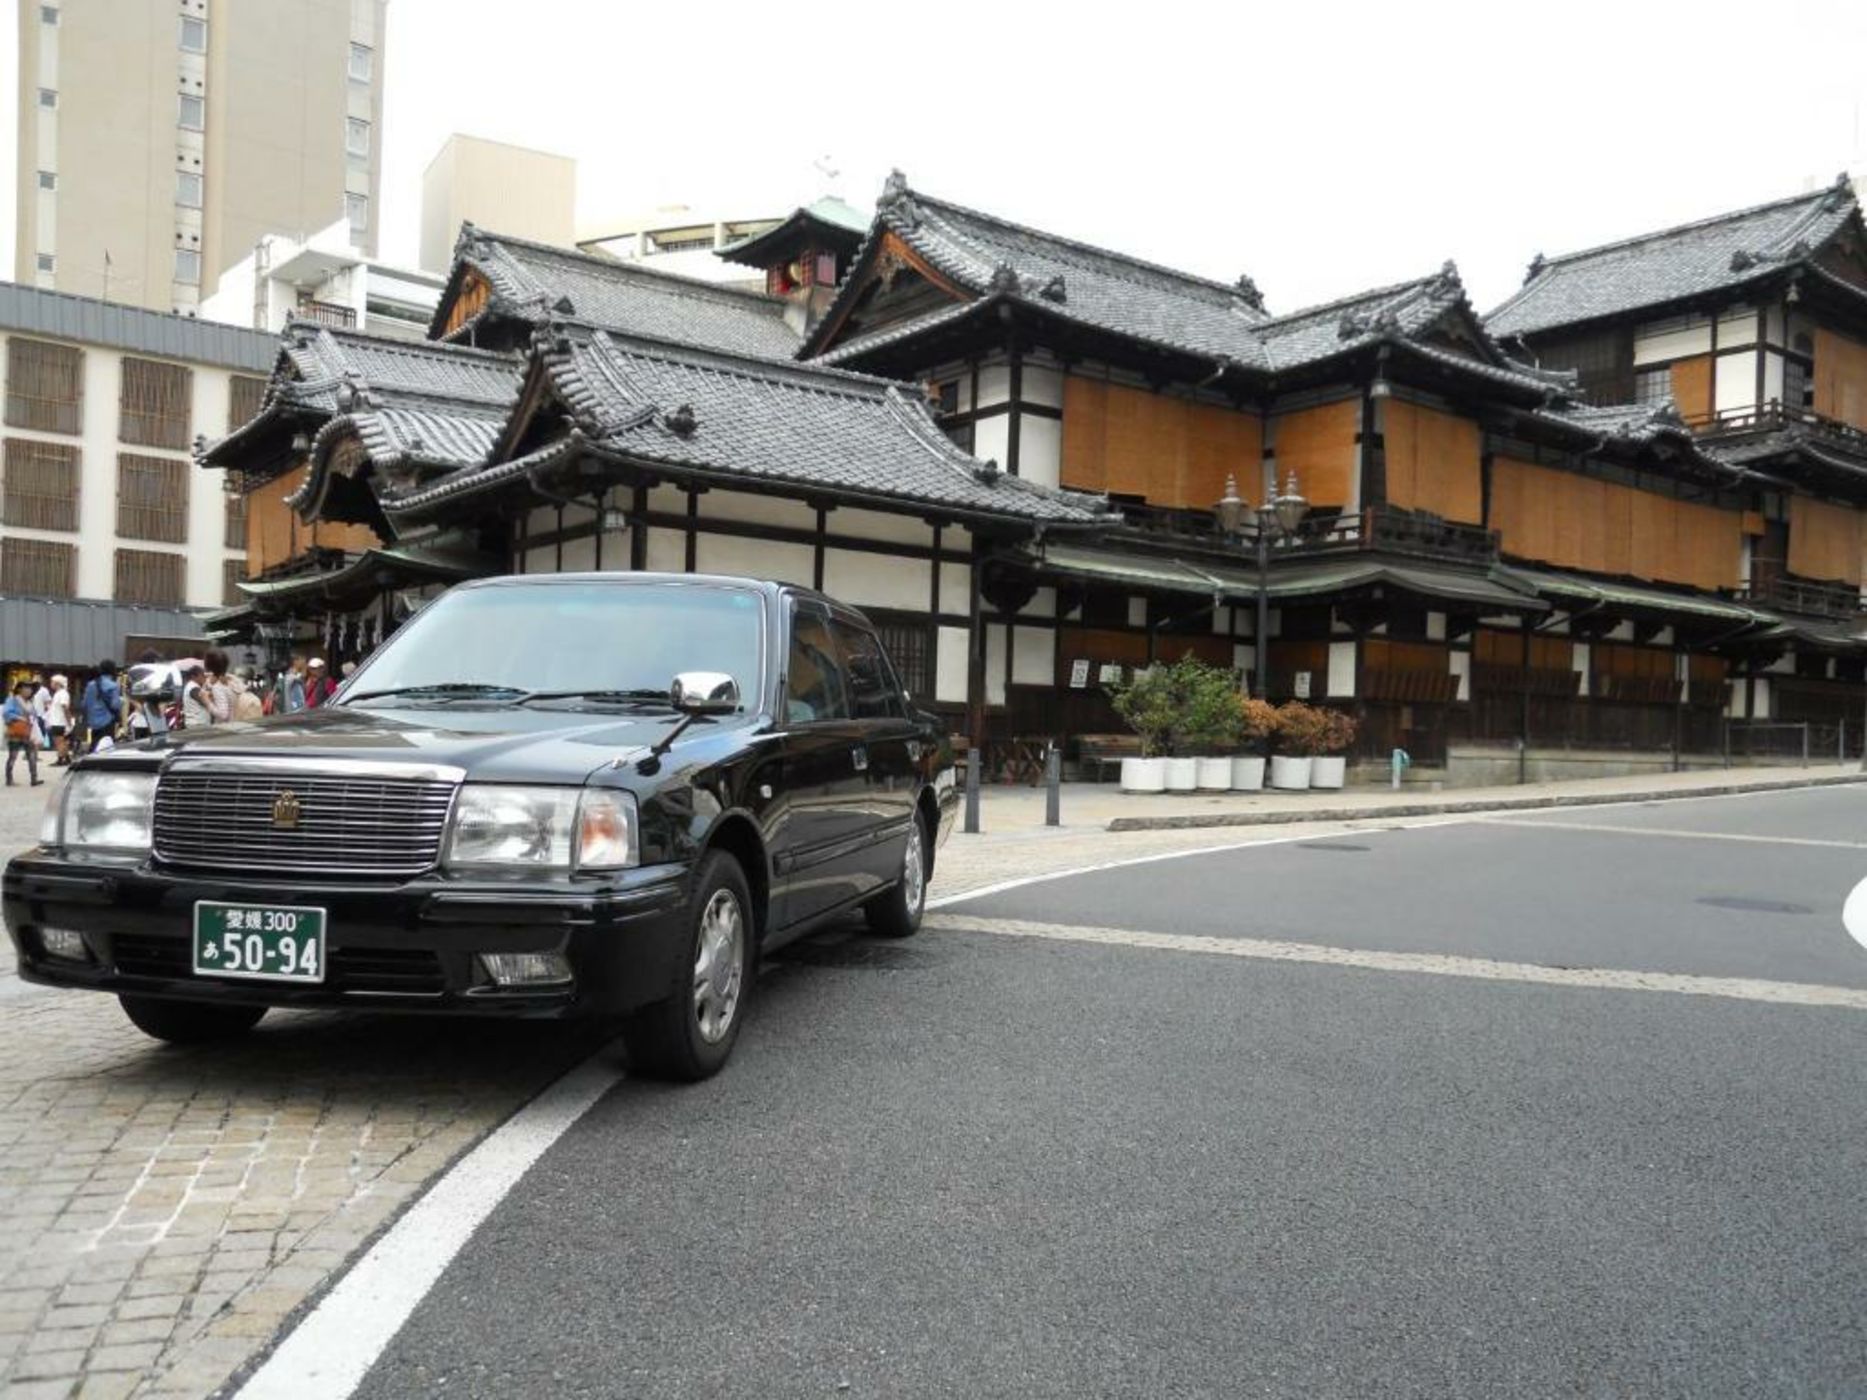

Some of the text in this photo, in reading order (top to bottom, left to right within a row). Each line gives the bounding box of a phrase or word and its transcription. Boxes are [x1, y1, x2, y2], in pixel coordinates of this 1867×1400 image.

[225, 909, 296, 932] 愛媛 300
[203, 932, 318, 975] あ 50-94
